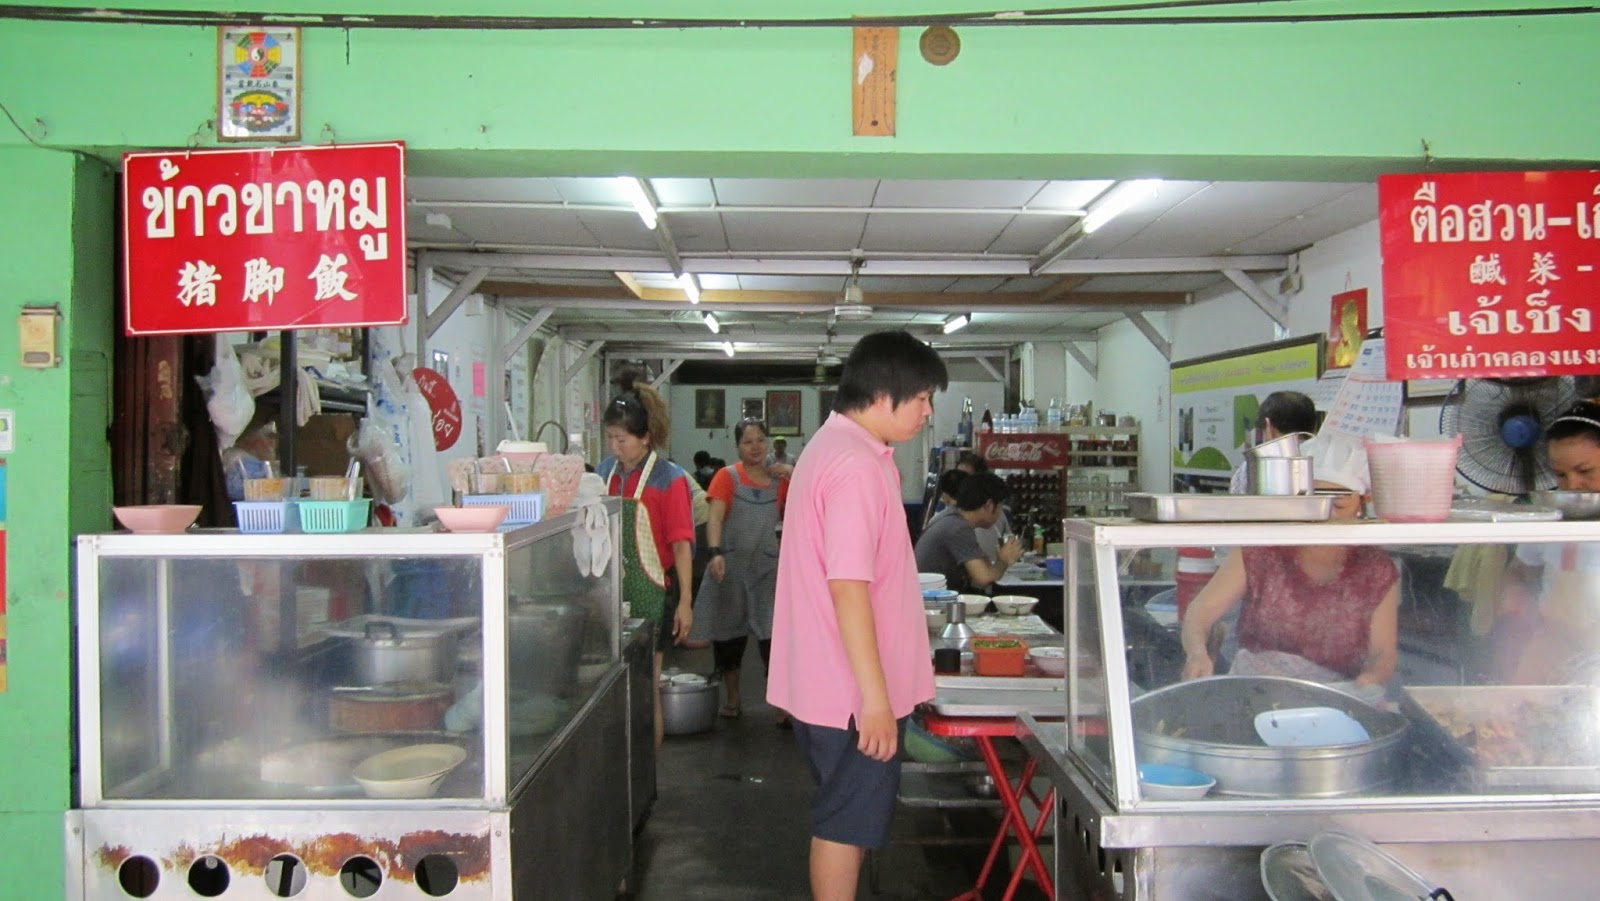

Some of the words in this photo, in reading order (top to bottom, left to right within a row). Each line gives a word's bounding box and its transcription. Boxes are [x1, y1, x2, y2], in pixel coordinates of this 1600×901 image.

[142, 158, 388, 261] ข้าวขาหมู
[1448, 289, 1592, 335] เจ้เช็ง
[984, 441, 1043, 461] Cocaola
